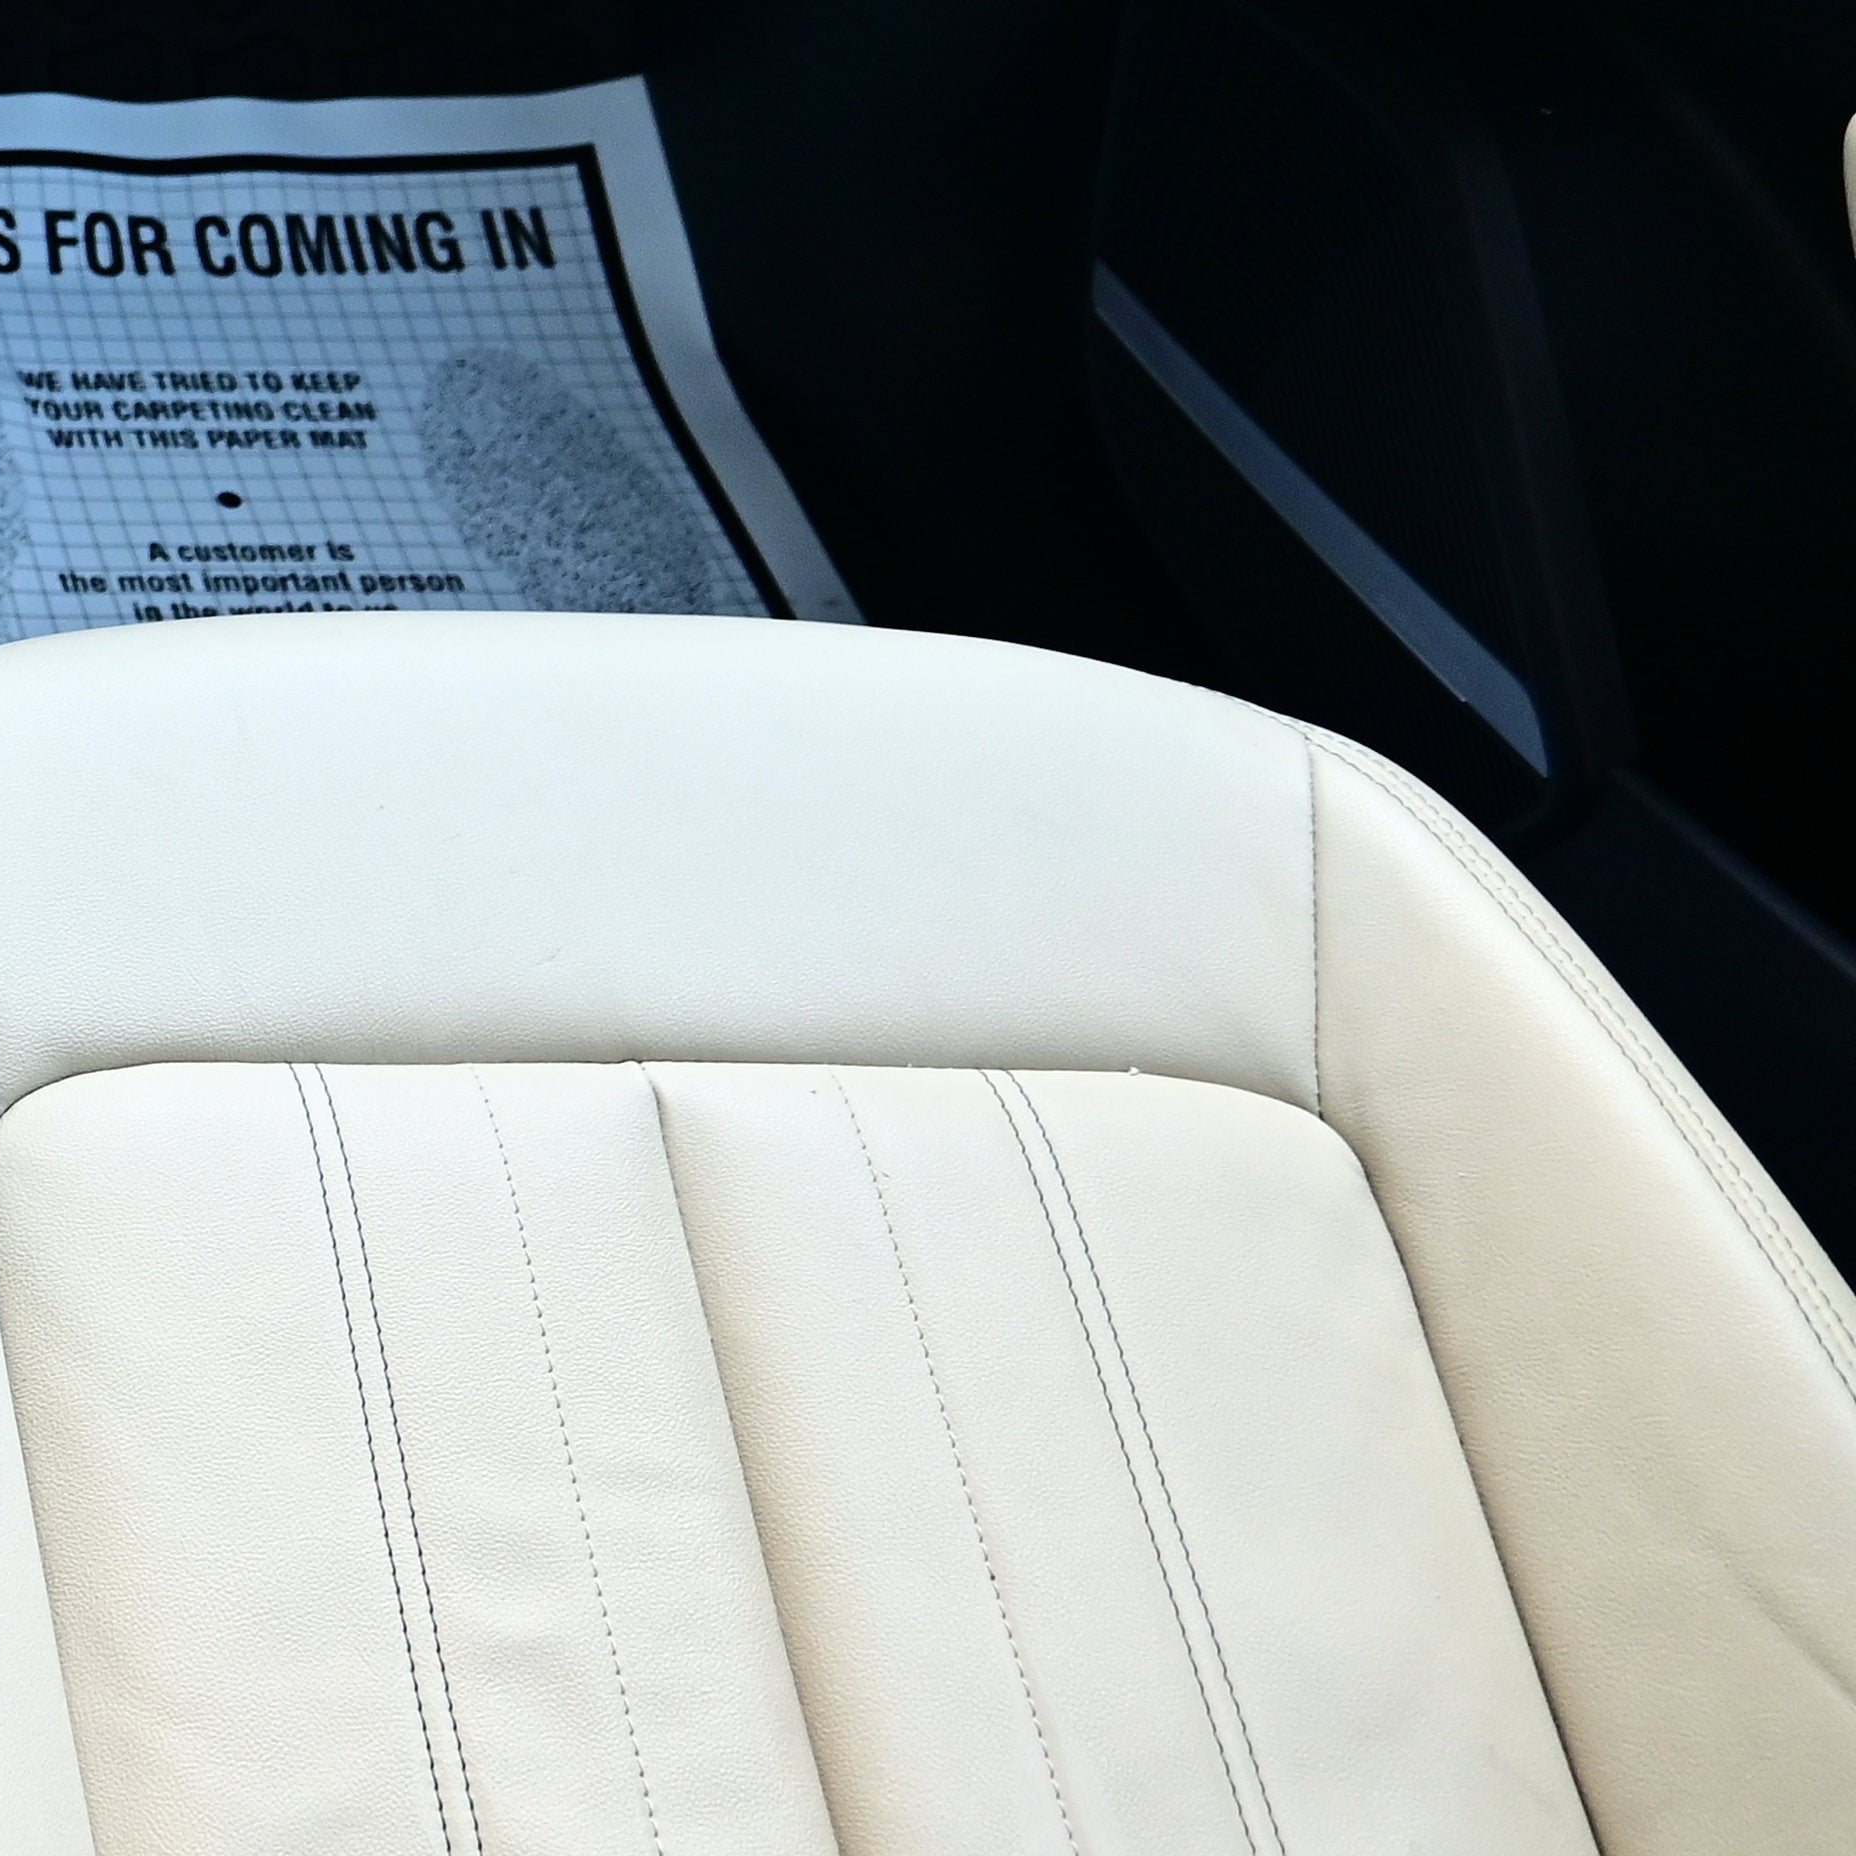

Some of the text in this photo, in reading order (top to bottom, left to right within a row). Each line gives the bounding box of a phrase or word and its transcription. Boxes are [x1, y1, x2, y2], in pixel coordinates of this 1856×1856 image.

[44, 209, 175, 277] FOR
[195, 209, 466, 277] COMING
[489, 207, 556, 269] IN
[17, 371, 362, 393] WE HAVE TRIED TO KEEP
[24, 397, 377, 422] YOUR CARPETING CLEAN
[47, 429, 369, 450] WITH THIS PAPER MAT
[149, 539, 355, 563] A customer is
[58, 569, 465, 596] the most important person
